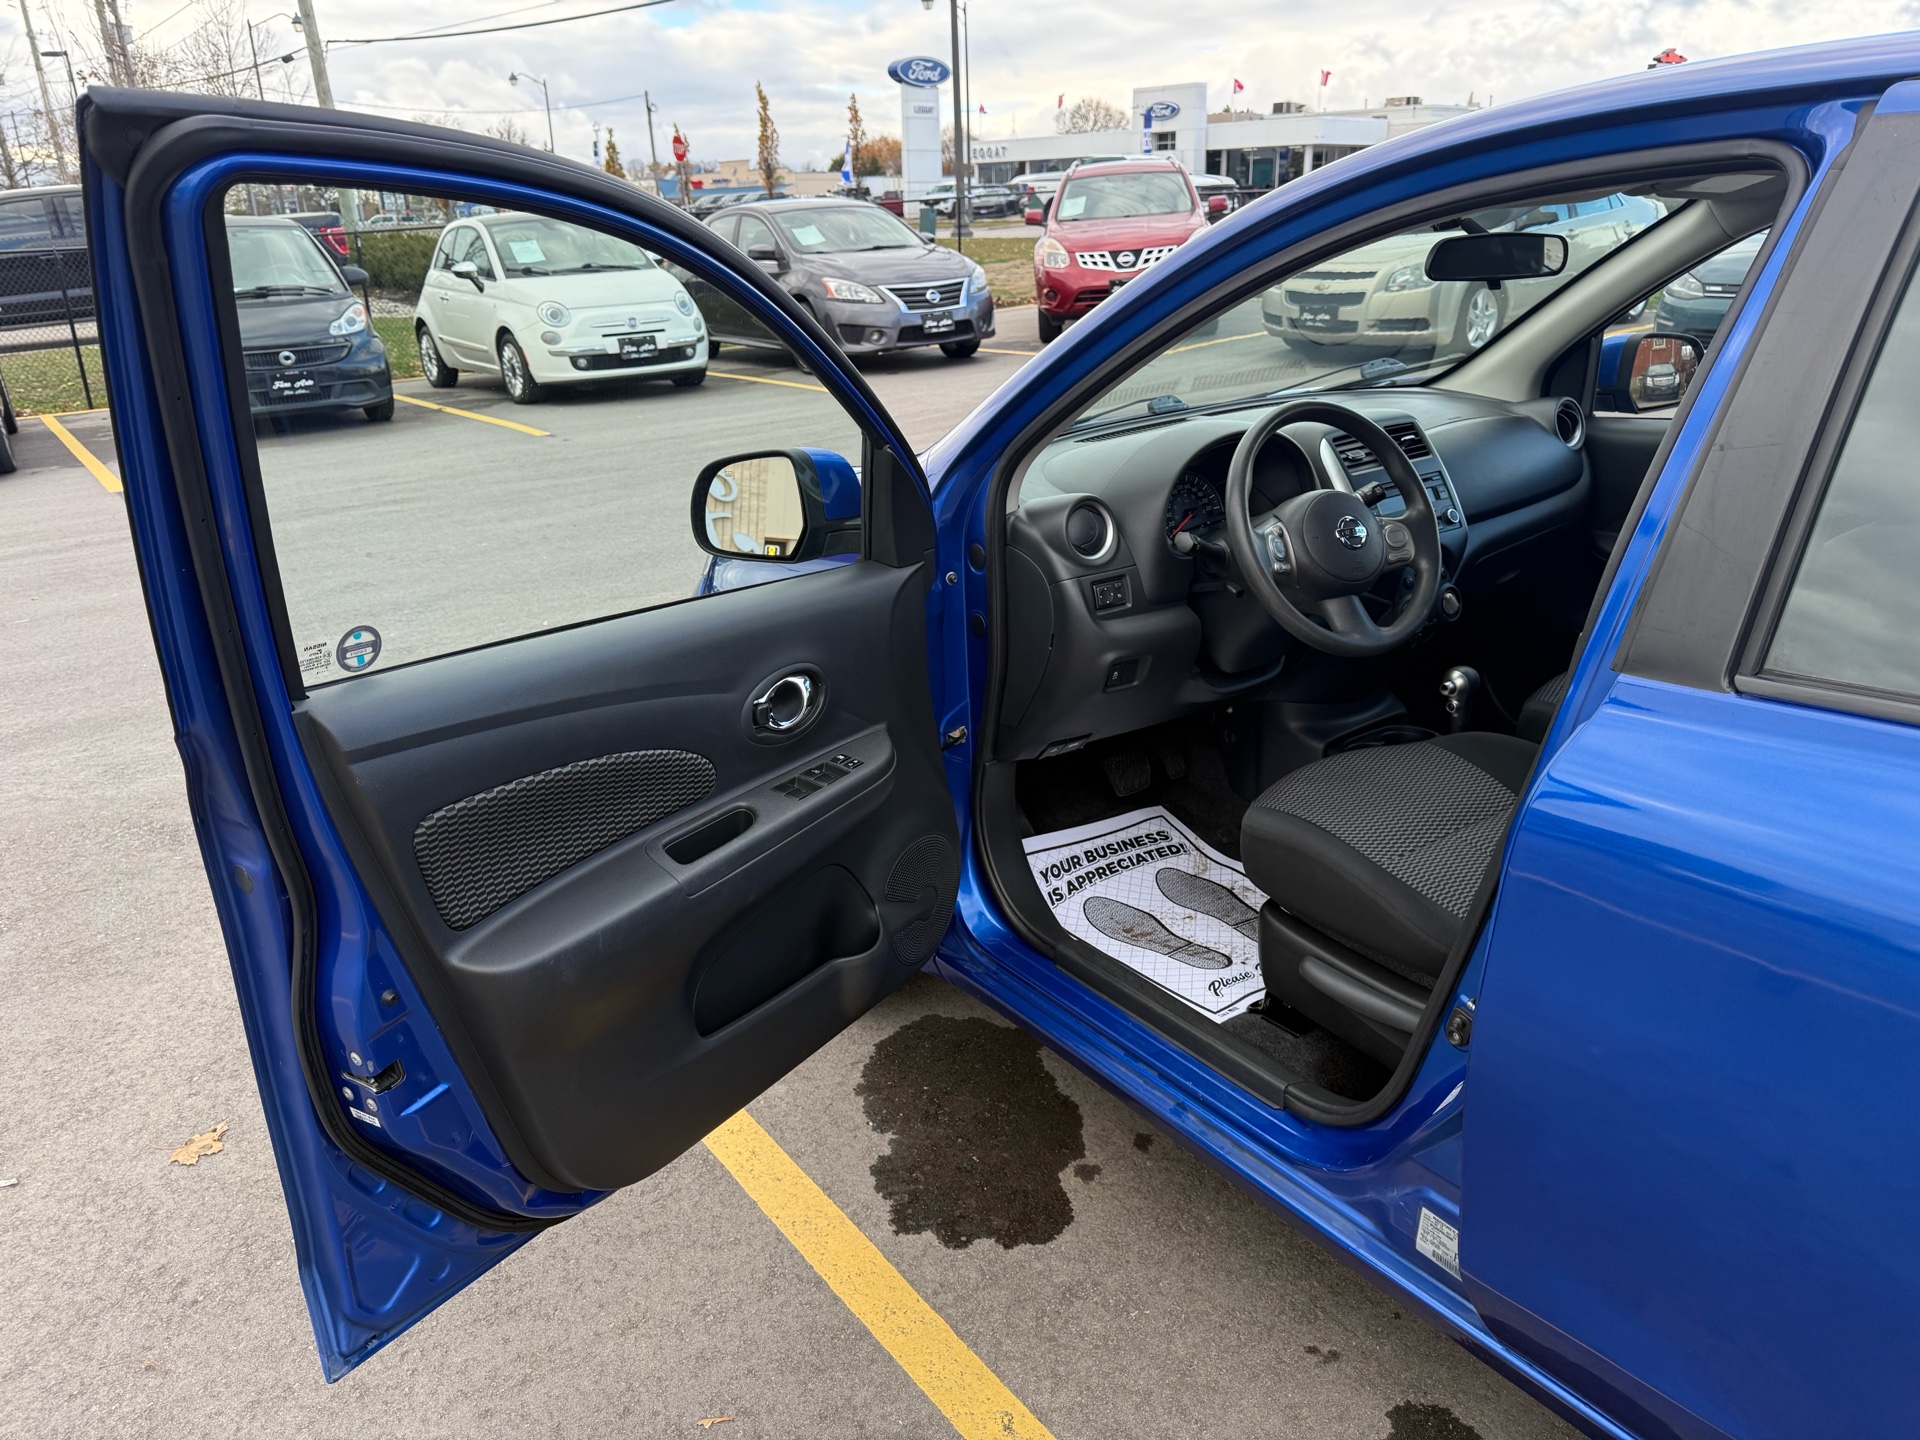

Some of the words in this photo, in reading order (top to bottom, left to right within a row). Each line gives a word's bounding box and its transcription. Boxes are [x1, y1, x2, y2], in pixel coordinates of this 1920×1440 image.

[908, 60, 941, 81] Ford
[1151, 104, 1173, 117] Ford
[972, 147, 1007, 159] EGGAT
[1039, 854, 1083, 885] YOUR
[1083, 830, 1171, 864] BUSINESS
[1047, 886, 1064, 907] IS
[1066, 843, 1189, 896] APPRECIATED!
